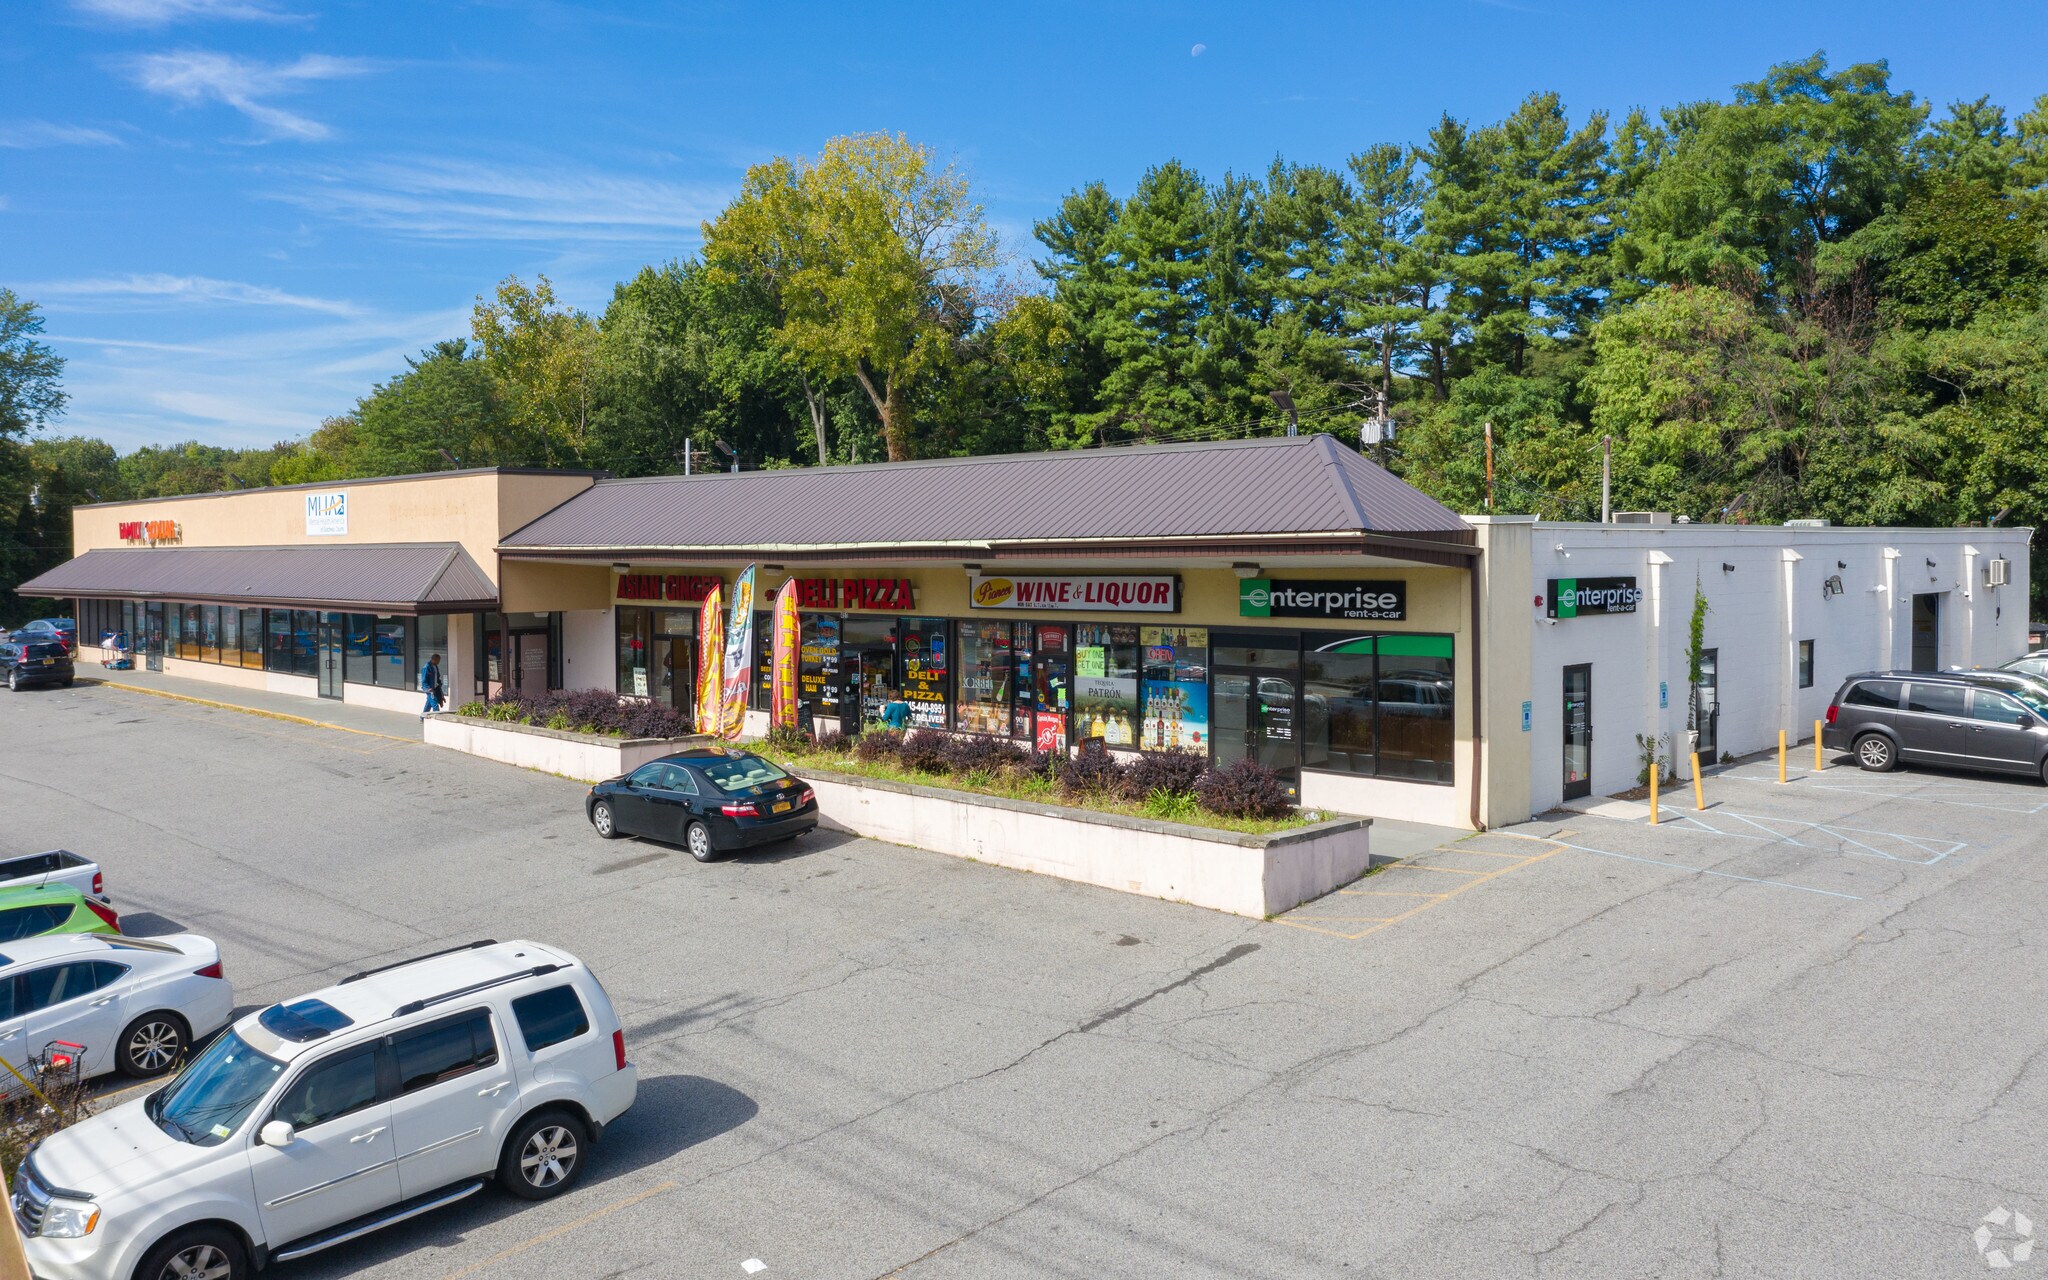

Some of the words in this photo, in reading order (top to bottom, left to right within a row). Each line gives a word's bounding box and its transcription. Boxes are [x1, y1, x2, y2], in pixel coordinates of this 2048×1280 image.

[616, 574, 662, 600] ASIAN
[842, 578, 916, 610] PIZZA
[977, 581, 1012, 603] Pioneer
[1016, 582, 1072, 603] WINE
[1072, 584, 1083, 600] &
[1084, 582, 1171, 607] LIQUOR
[1558, 583, 1643, 610] enterprise
[1241, 587, 1398, 614] enterprise
[1606, 604, 1635, 612] rent-a-car
[1344, 609, 1402, 619] rent-a-car
[1077, 648, 1091, 659] BUY
[1092, 649, 1104, 659] ONE
[1147, 648, 1174, 661] OPEN
[1092, 660, 1104, 670] ONE
[801, 674, 826, 684] DELUXE
[908, 670, 939, 681] DELI
[805, 684, 817, 693] HAM
[917, 681, 929, 690] &
[962, 677, 994, 690] KORBEL
[1094, 679, 1114, 687] TEQUILA
[903, 690, 944, 702] PIZZA
[905, 701, 946, 714] 45-440-8951
[916, 713, 945, 724] DELIVER
